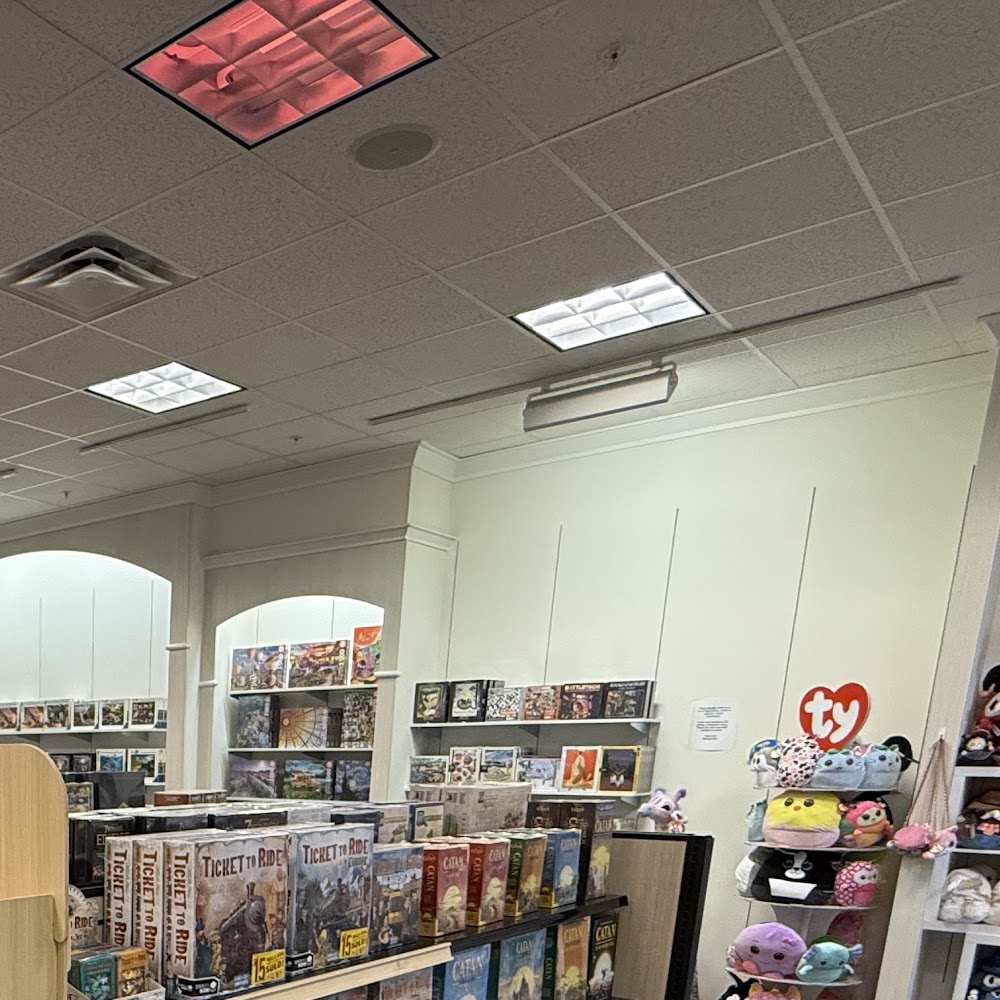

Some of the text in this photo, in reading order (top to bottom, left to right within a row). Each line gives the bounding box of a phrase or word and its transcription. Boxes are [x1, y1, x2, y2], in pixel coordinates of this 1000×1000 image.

[805, 690, 860, 744] ty
[202, 847, 283, 878] TICKET TO RIDE
[302, 844, 338, 864] TICKET
[339, 844, 347, 857] TO
[348, 837, 369, 856] RIDE
[443, 855, 465, 871] CATAN
[113, 849, 128, 904] TICKET
[473, 857, 483, 883] CATAN
[511, 852, 521, 876] CATAN
[142, 850, 157, 907] TICKET
[426, 866, 436, 892] CATAN
[115, 905, 124, 919] TO
[145, 907, 154, 922] TO
[173, 852, 190, 966] TICKET TO RIDE
[74, 916, 94, 930] RIDE
[114, 921, 127, 946] RID
[563, 928, 583, 944] CATAN
[595, 923, 616, 942] CATAN
[341, 932, 352, 957] 15
[253, 956, 266, 983] 15
[452, 955, 483, 982] CATAN
